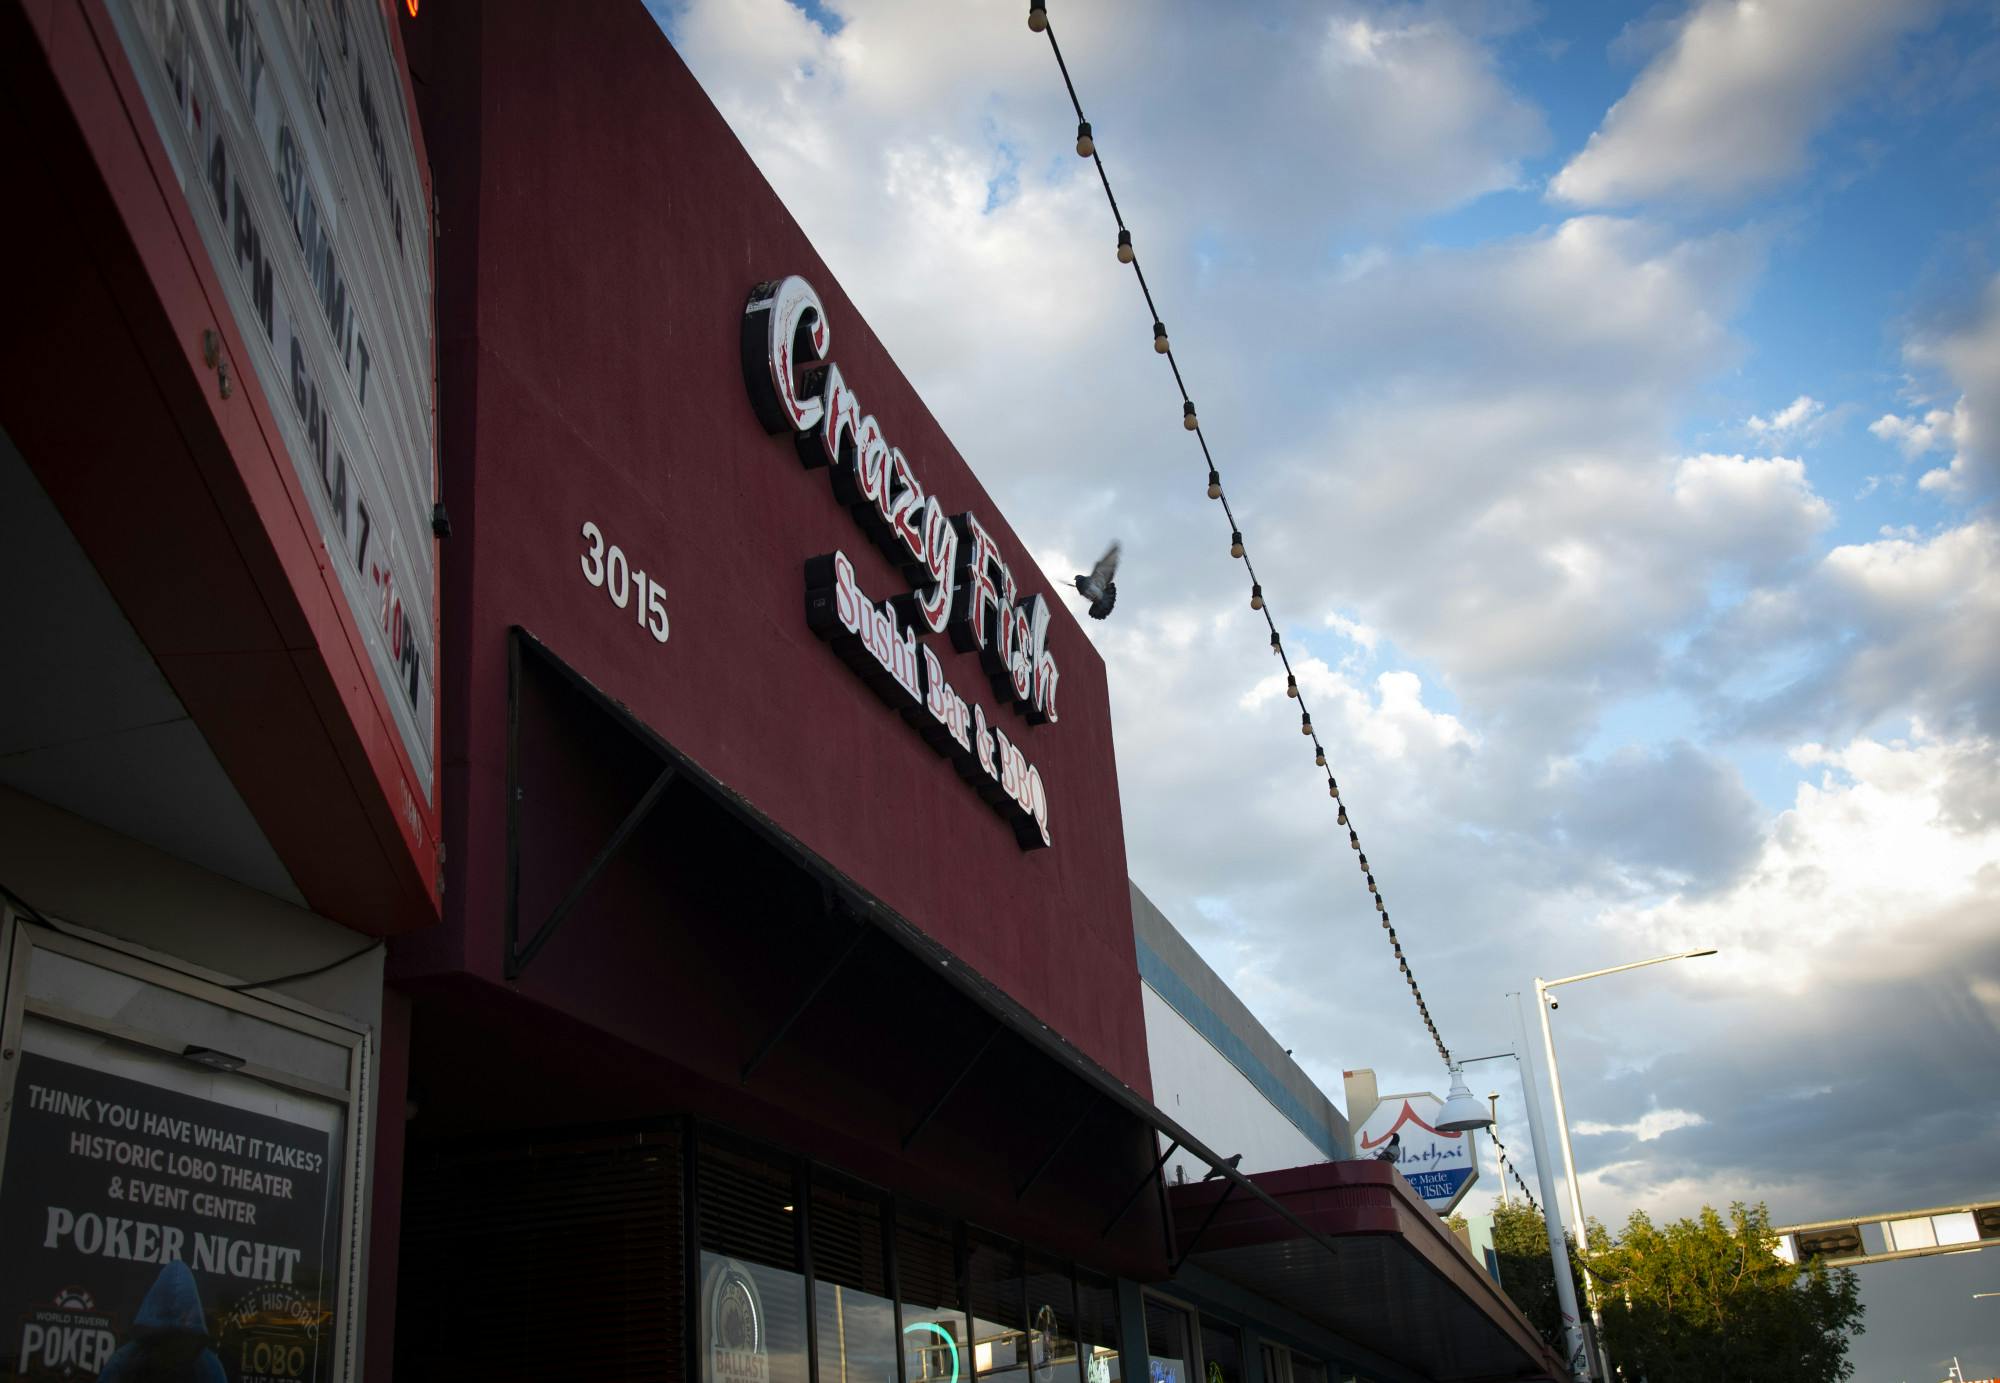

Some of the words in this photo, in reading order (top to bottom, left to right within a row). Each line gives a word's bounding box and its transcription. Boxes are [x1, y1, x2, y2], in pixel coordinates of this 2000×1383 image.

[290, 335, 348, 540] GALA
[762, 275, 958, 633] Crazy
[966, 511, 1059, 723] Fish
[580, 521, 669, 643] 3015
[833, 550, 922, 704] Sushi
[922, 643, 972, 752] Bar
[973, 703, 1001, 782] &
[996, 727, 1050, 847] BBQ
[29, 1084, 93, 1121] THINK
[95, 1100, 139, 1130] YOU
[143, 1111, 191, 1144] HAVE
[193, 1124, 246, 1156] WHAT
[248, 1138, 264, 1160] IT
[265, 1142, 322, 1174] TAKES?
[70, 1131, 164, 1173] HISTORIC
[167, 1152, 217, 1183] LOBO
[221, 1164, 293, 1200] THEATER
[1414, 1182, 1454, 1198] UISINE
[1420, 1172, 1448, 1185] Made
[107, 1175, 125, 1200] &
[129, 1179, 190, 1212] EVENT
[192, 1192, 256, 1226] CENTER
[43, 1206, 184, 1266] POKER
[191, 1231, 301, 1285] NIGHT
[36, 1310, 71, 1324] WORLD
[74, 1314, 110, 1328] TAVERN
[231, 1297, 258, 1329] THE
[261, 1293, 320, 1340] HISTORIC
[18, 1322, 116, 1376] POKER
[241, 1341, 305, 1376] LOBO
[715, 1350, 765, 1379] BALLAST
